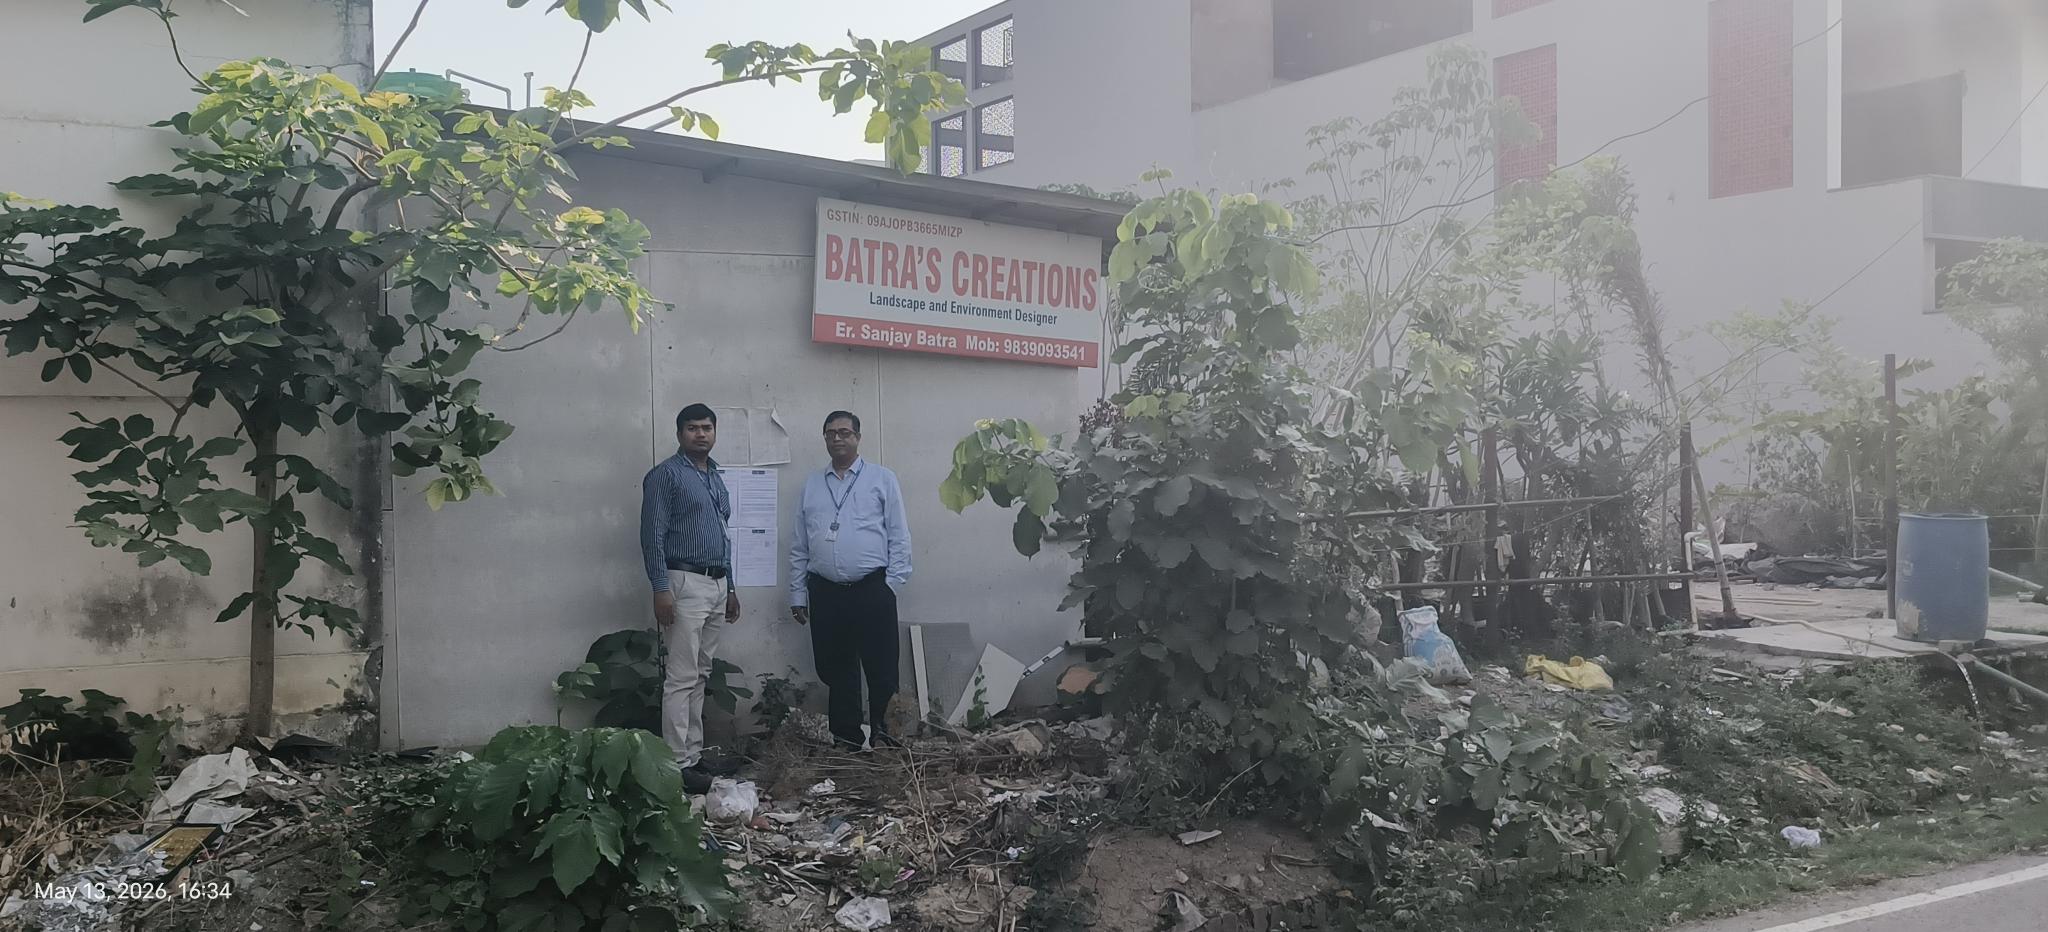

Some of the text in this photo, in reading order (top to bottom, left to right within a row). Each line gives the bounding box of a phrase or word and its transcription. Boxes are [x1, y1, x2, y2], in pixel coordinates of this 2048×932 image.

[826, 208, 864, 226] GSTIN:
[825, 233, 1098, 311] BATRA'S CREATIONS
[869, 291, 1058, 326] Landscape and Environment Designer
[835, 322, 1086, 361] Er. Sanjay Batra Mob: 9839093541
